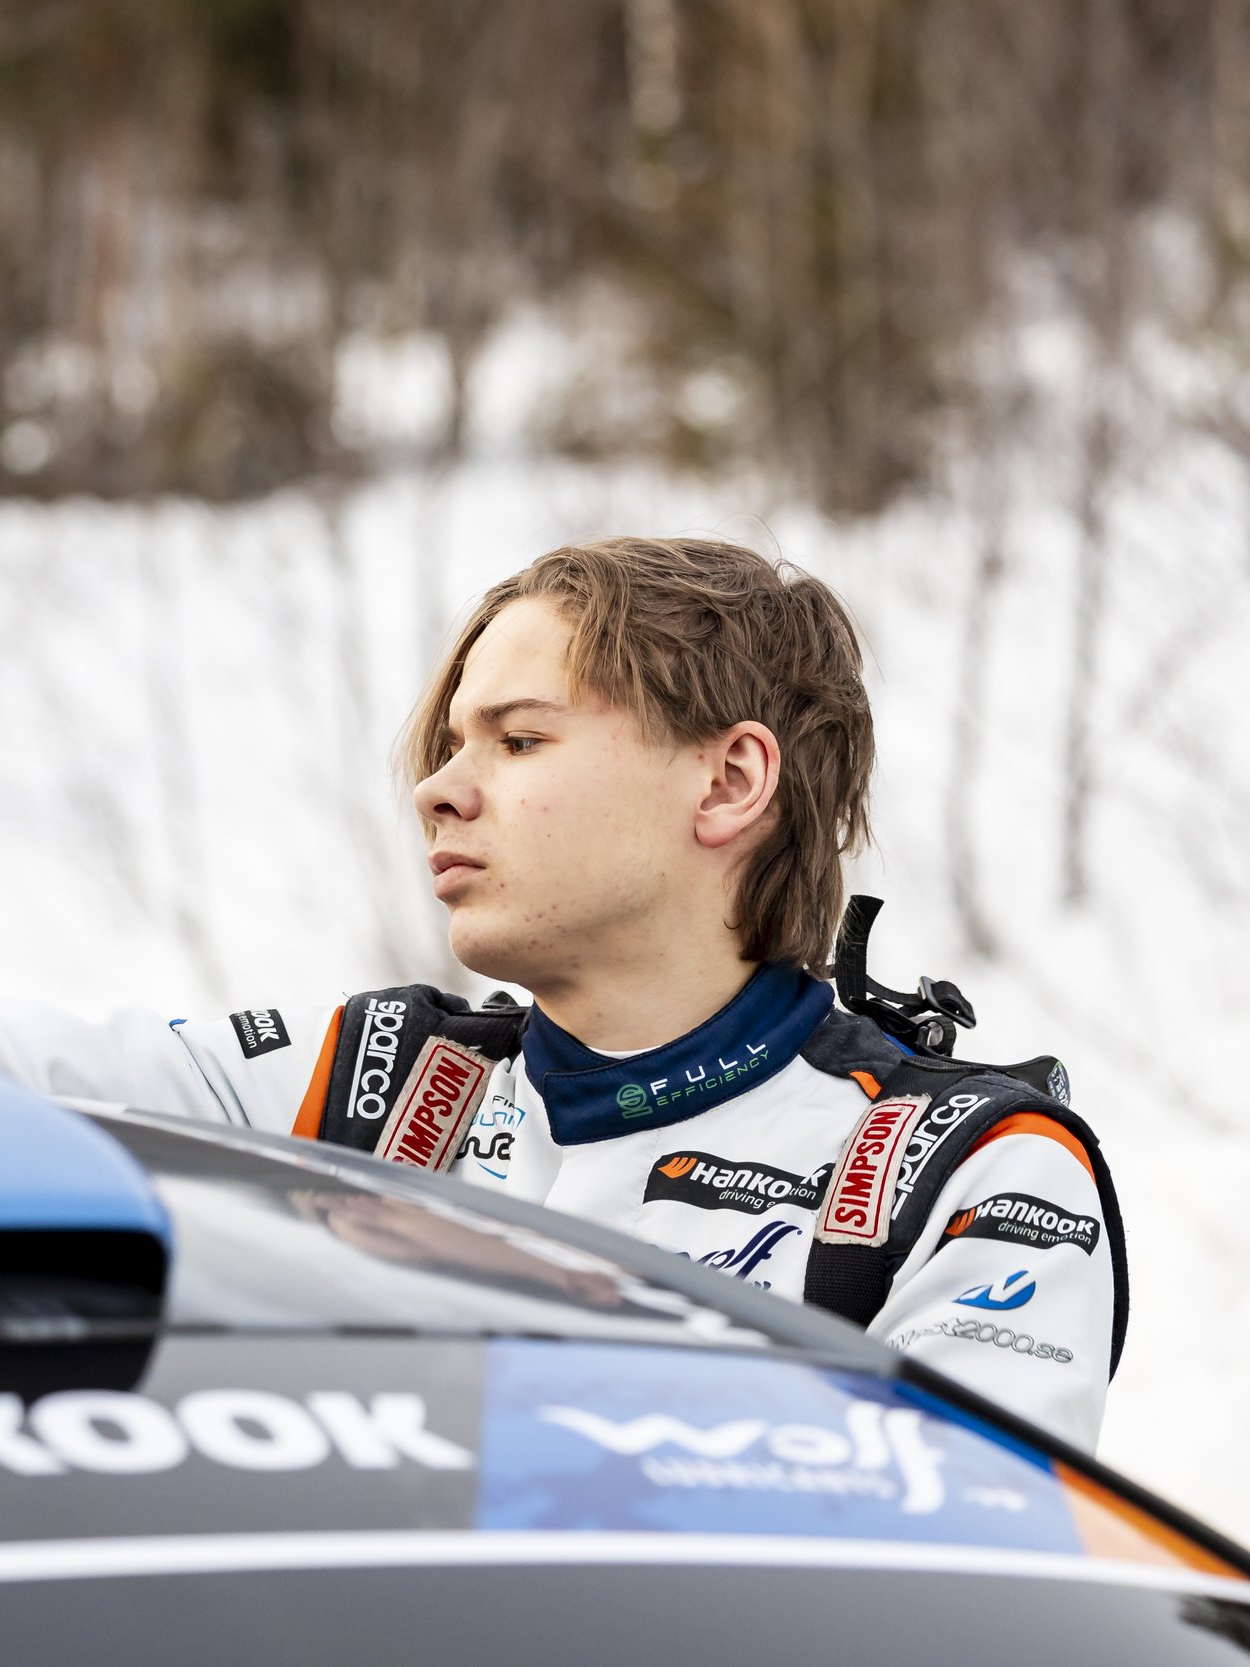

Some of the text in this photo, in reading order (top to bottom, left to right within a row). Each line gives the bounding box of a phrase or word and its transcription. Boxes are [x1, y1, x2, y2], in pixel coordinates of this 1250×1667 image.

[356, 1000, 407, 1120] sparco
[649, 1043, 766, 1096] FULL
[656, 1049, 770, 1107] EFFICIENCY
[834, 1111, 902, 1228] SIMPSON
[893, 1094, 979, 1203] parco
[689, 1161, 828, 1199] Hankok
[718, 1185, 817, 1209] driving eion
[997, 1221, 1040, 1240] driving
